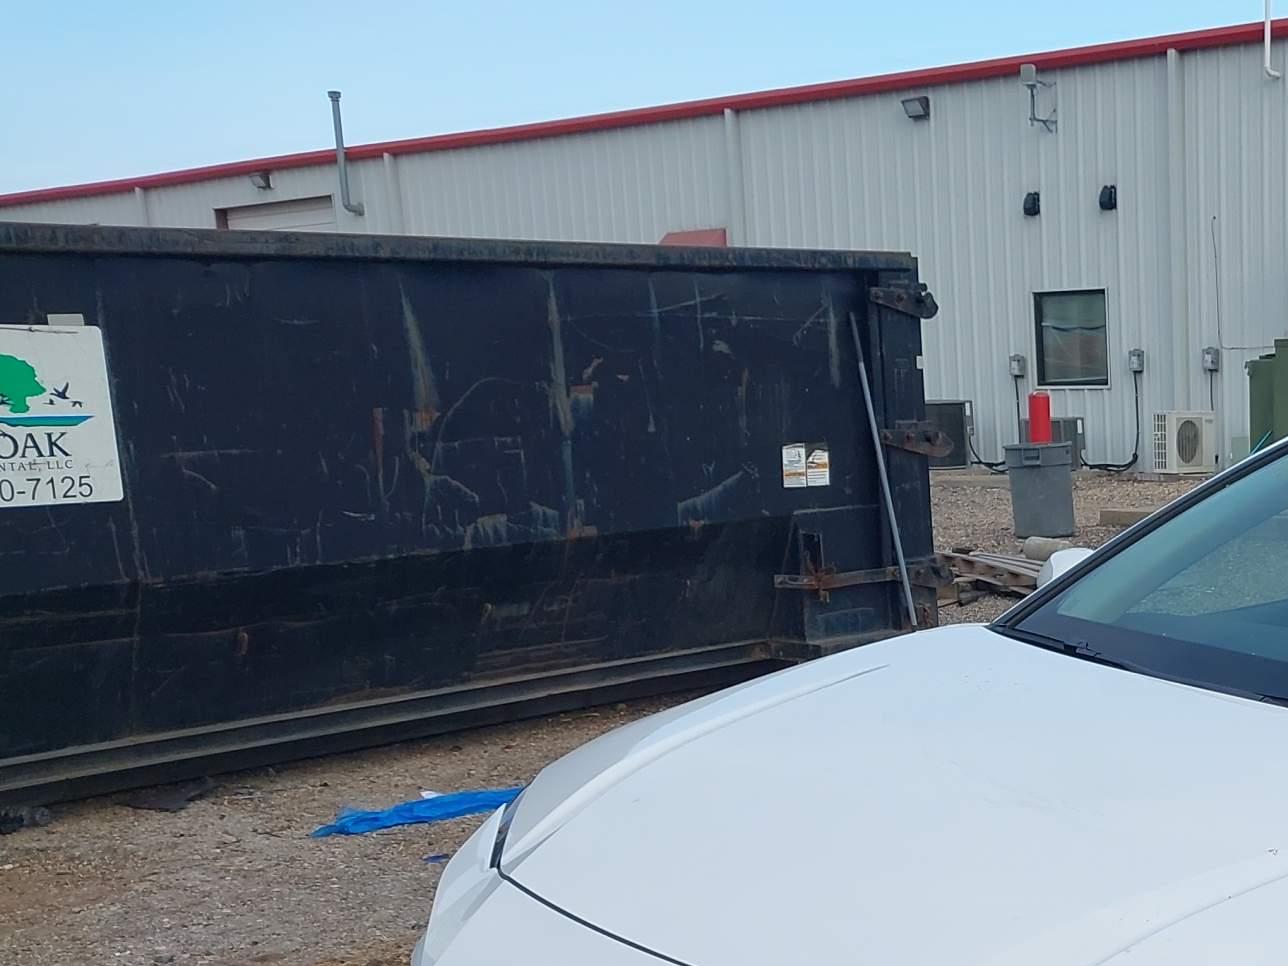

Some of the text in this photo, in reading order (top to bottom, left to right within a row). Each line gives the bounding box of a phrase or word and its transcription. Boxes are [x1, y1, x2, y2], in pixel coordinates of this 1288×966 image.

[0, 431, 72, 459] OAK
[47, 459, 73, 470] LLC
[0, 475, 93, 502] 0-7125
